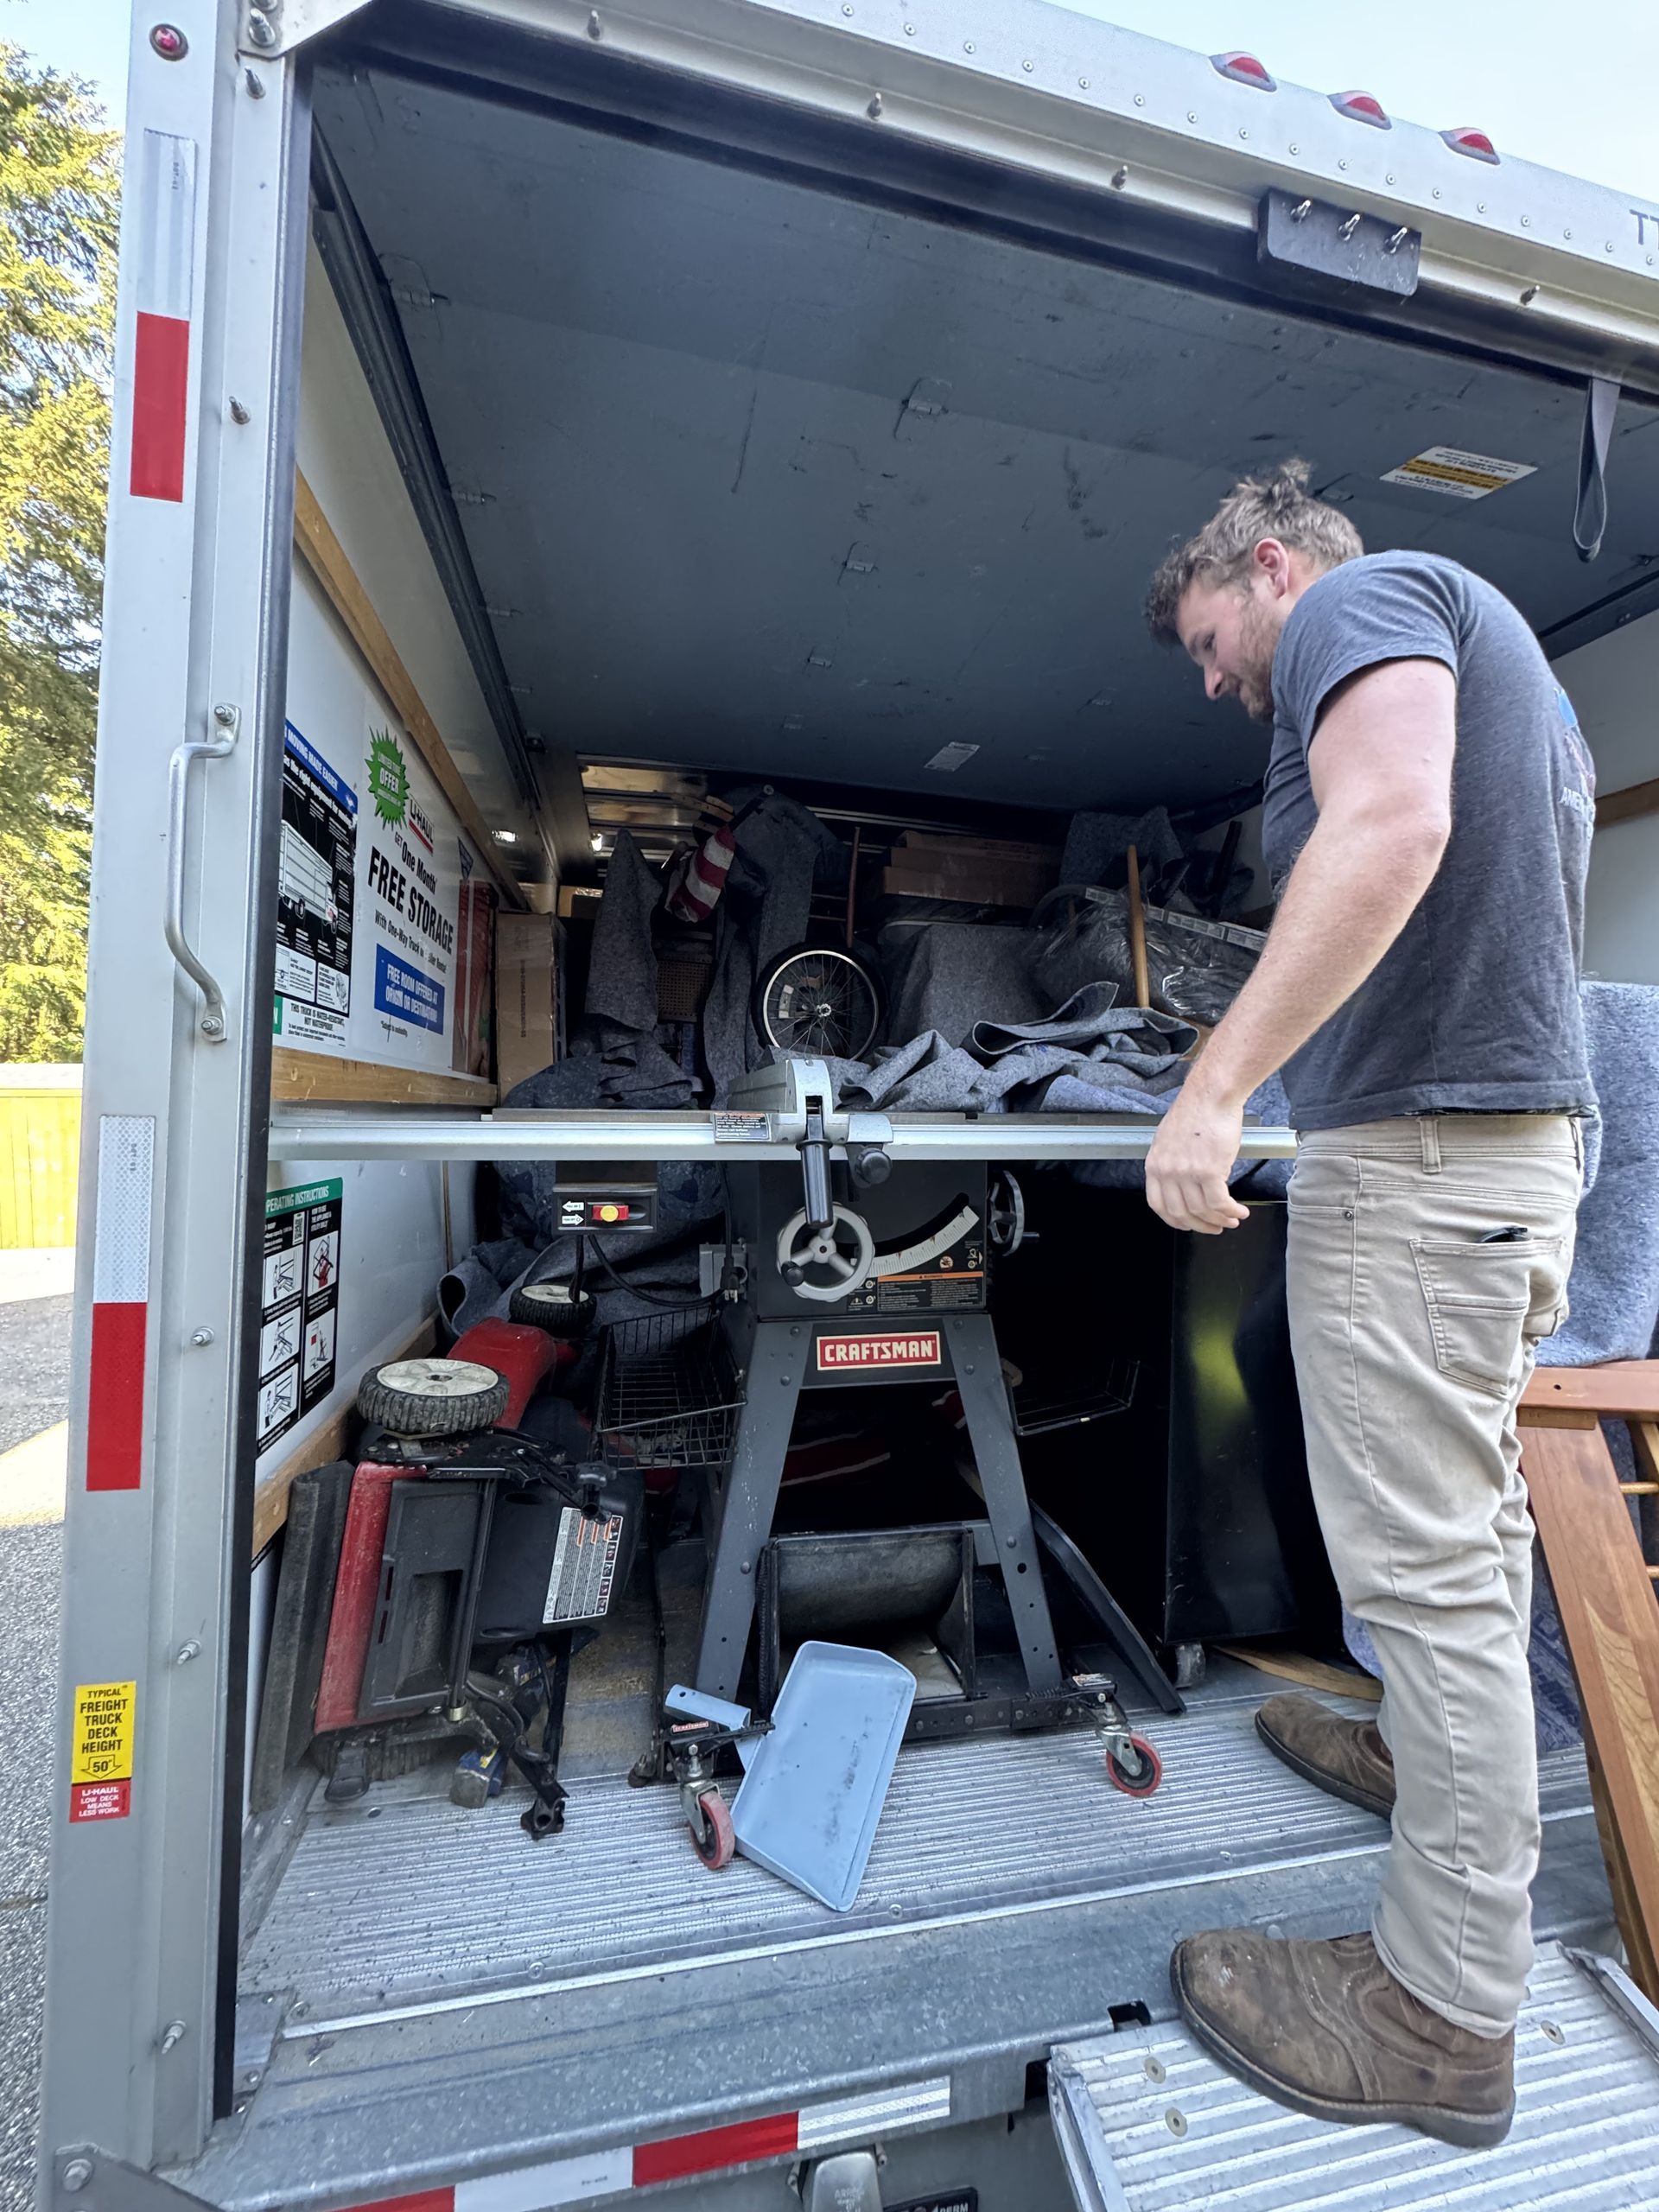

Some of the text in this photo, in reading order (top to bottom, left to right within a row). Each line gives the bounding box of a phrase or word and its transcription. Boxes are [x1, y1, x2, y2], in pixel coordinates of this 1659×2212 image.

[379, 766, 399, 795] OFFER
[410, 799, 434, 843] U-HAUL
[402, 842, 416, 872] One
[367, 845, 406, 913] FREE
[408, 886, 454, 956] STORAGE
[374, 909, 387, 931] With
[388, 919, 408, 948] One-Way
[409, 936, 420, 954] Truck
[387, 963, 401, 985] FREE
[400, 971, 415, 993] ROOM
[415, 980, 433, 1002] OFFERED
[265, 1185, 329, 1213] PERATING INSTRUCTIONS
[824, 1340, 933, 1362] CRAFTSMAN
[87, 1688, 121, 1699] TYPICAL
[79, 1699, 129, 1713] FREIGHT
[84, 1713, 123, 1726] TRUCK
[87, 1726, 118, 1739] DECK
[81, 1739, 123, 1755] HEIGHT
[80, 1796, 98, 1805] LOW
[81, 1786, 119, 1797] U-HAUL
[87, 1801, 112, 1809] MEANS
